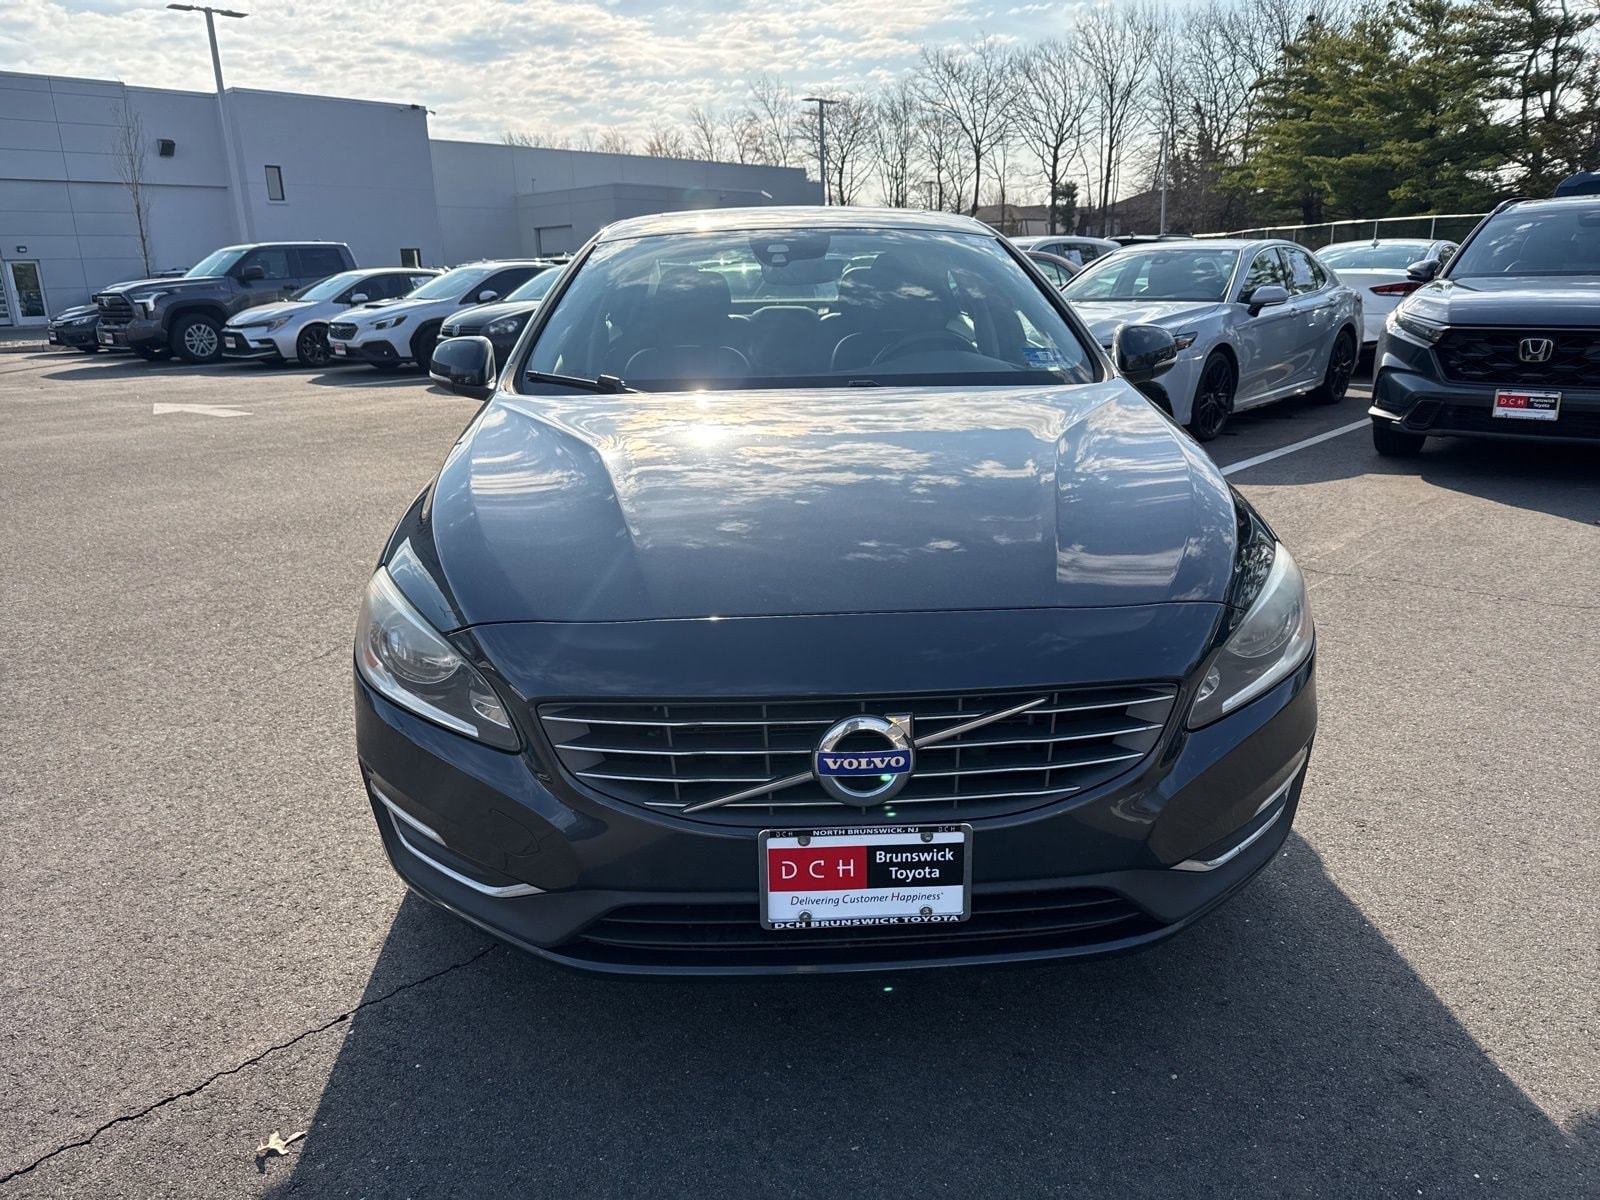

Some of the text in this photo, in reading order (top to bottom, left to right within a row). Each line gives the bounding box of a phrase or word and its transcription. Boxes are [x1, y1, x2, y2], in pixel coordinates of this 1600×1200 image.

[823, 756, 905, 770] VOLVO
[907, 825, 919, 833] NJ
[875, 847, 954, 863] Brunswick
[781, 858, 854, 880] DCH
[888, 866, 940, 882] Toyota
[790, 895, 840, 907] Delivering
[842, 894, 889, 904] Customer
[774, 915, 960, 929] DCH BRUNSWICK TOYOTA
